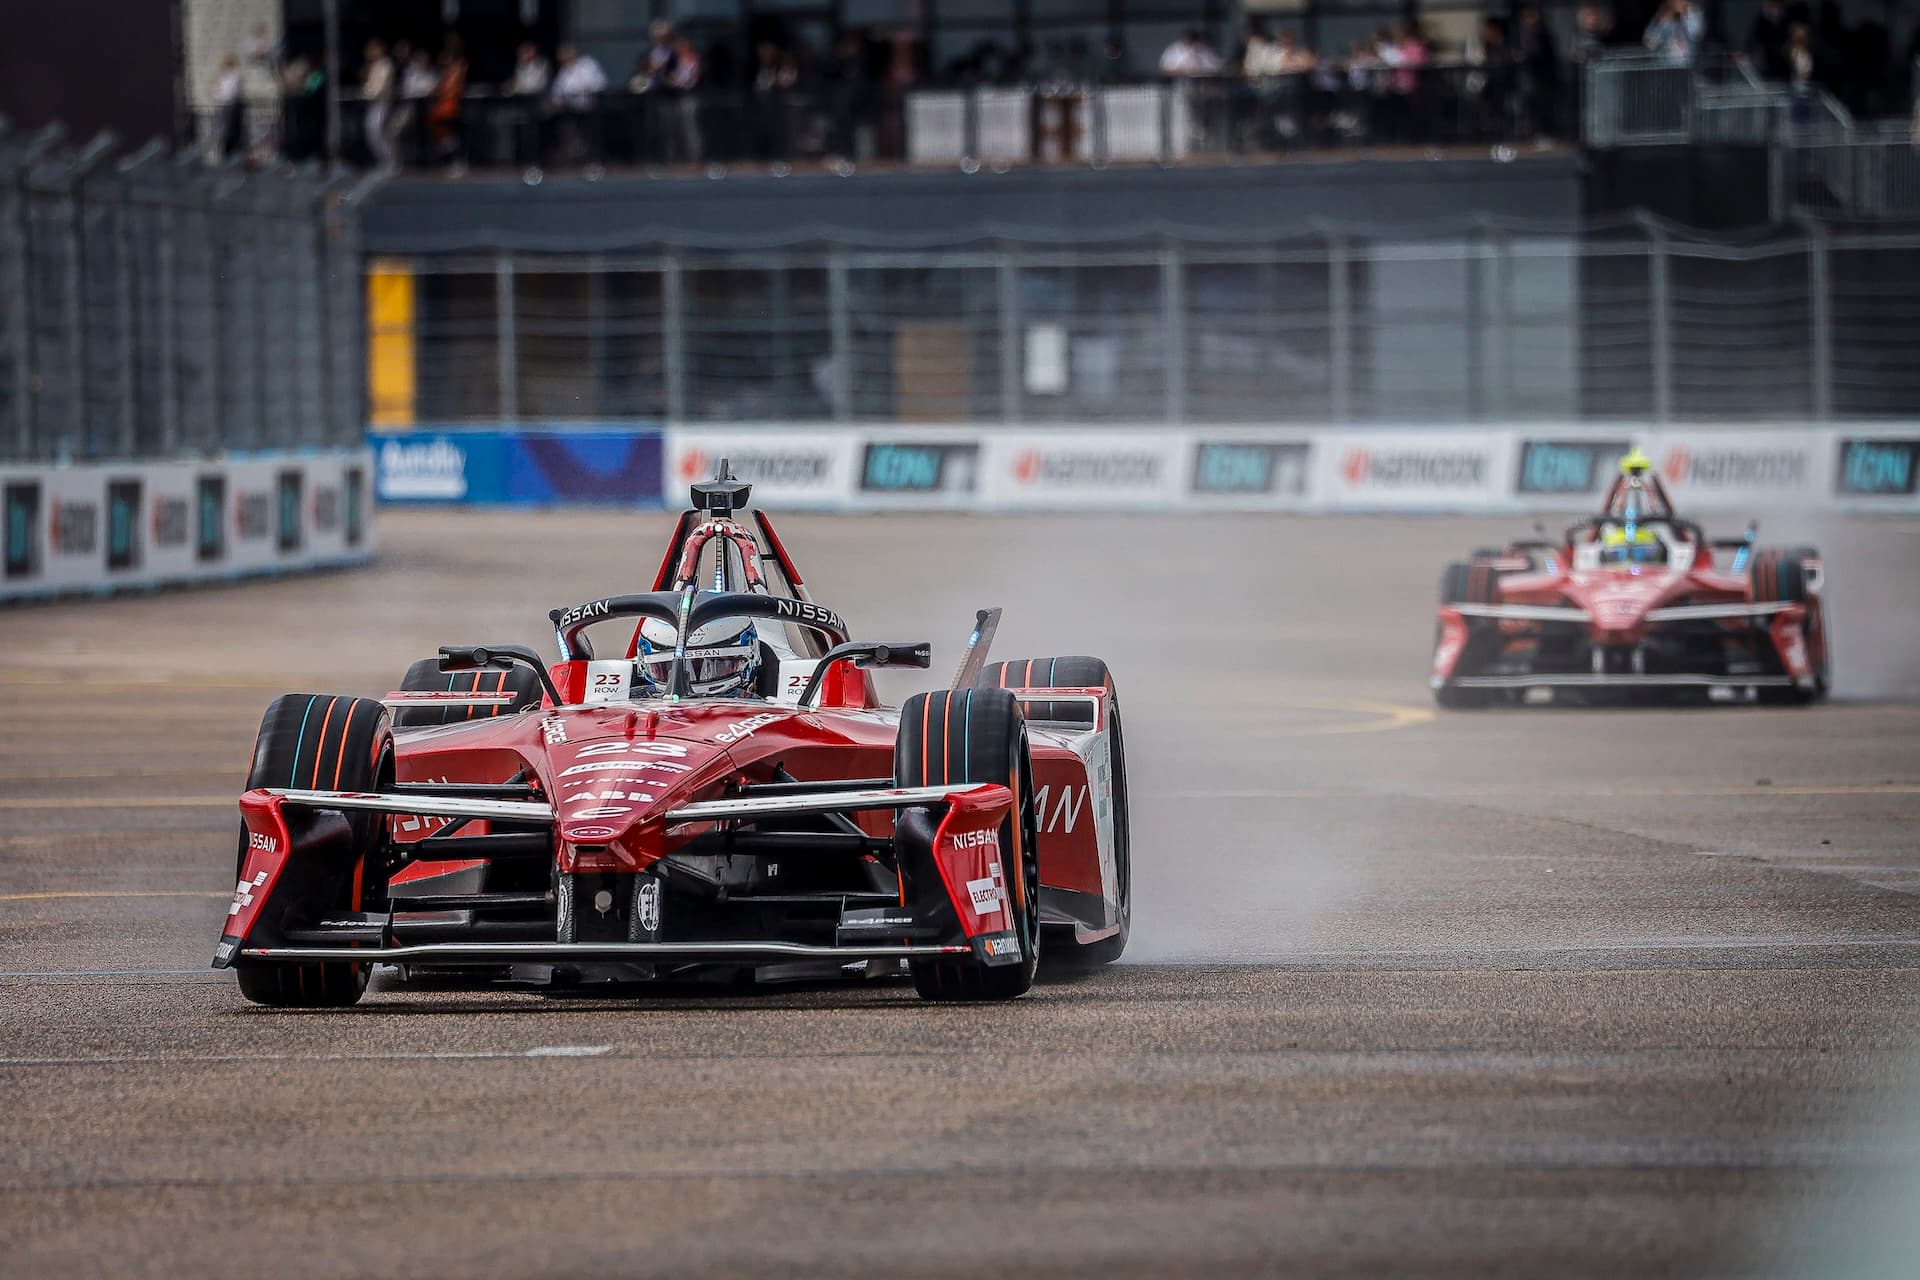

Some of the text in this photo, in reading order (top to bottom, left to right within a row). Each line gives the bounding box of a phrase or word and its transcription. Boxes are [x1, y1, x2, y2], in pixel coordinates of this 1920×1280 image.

[595, 674, 621, 685] 23
[788, 676, 812, 687] 23
[575, 742, 688, 759] 23
[563, 791, 654, 804] ABB
